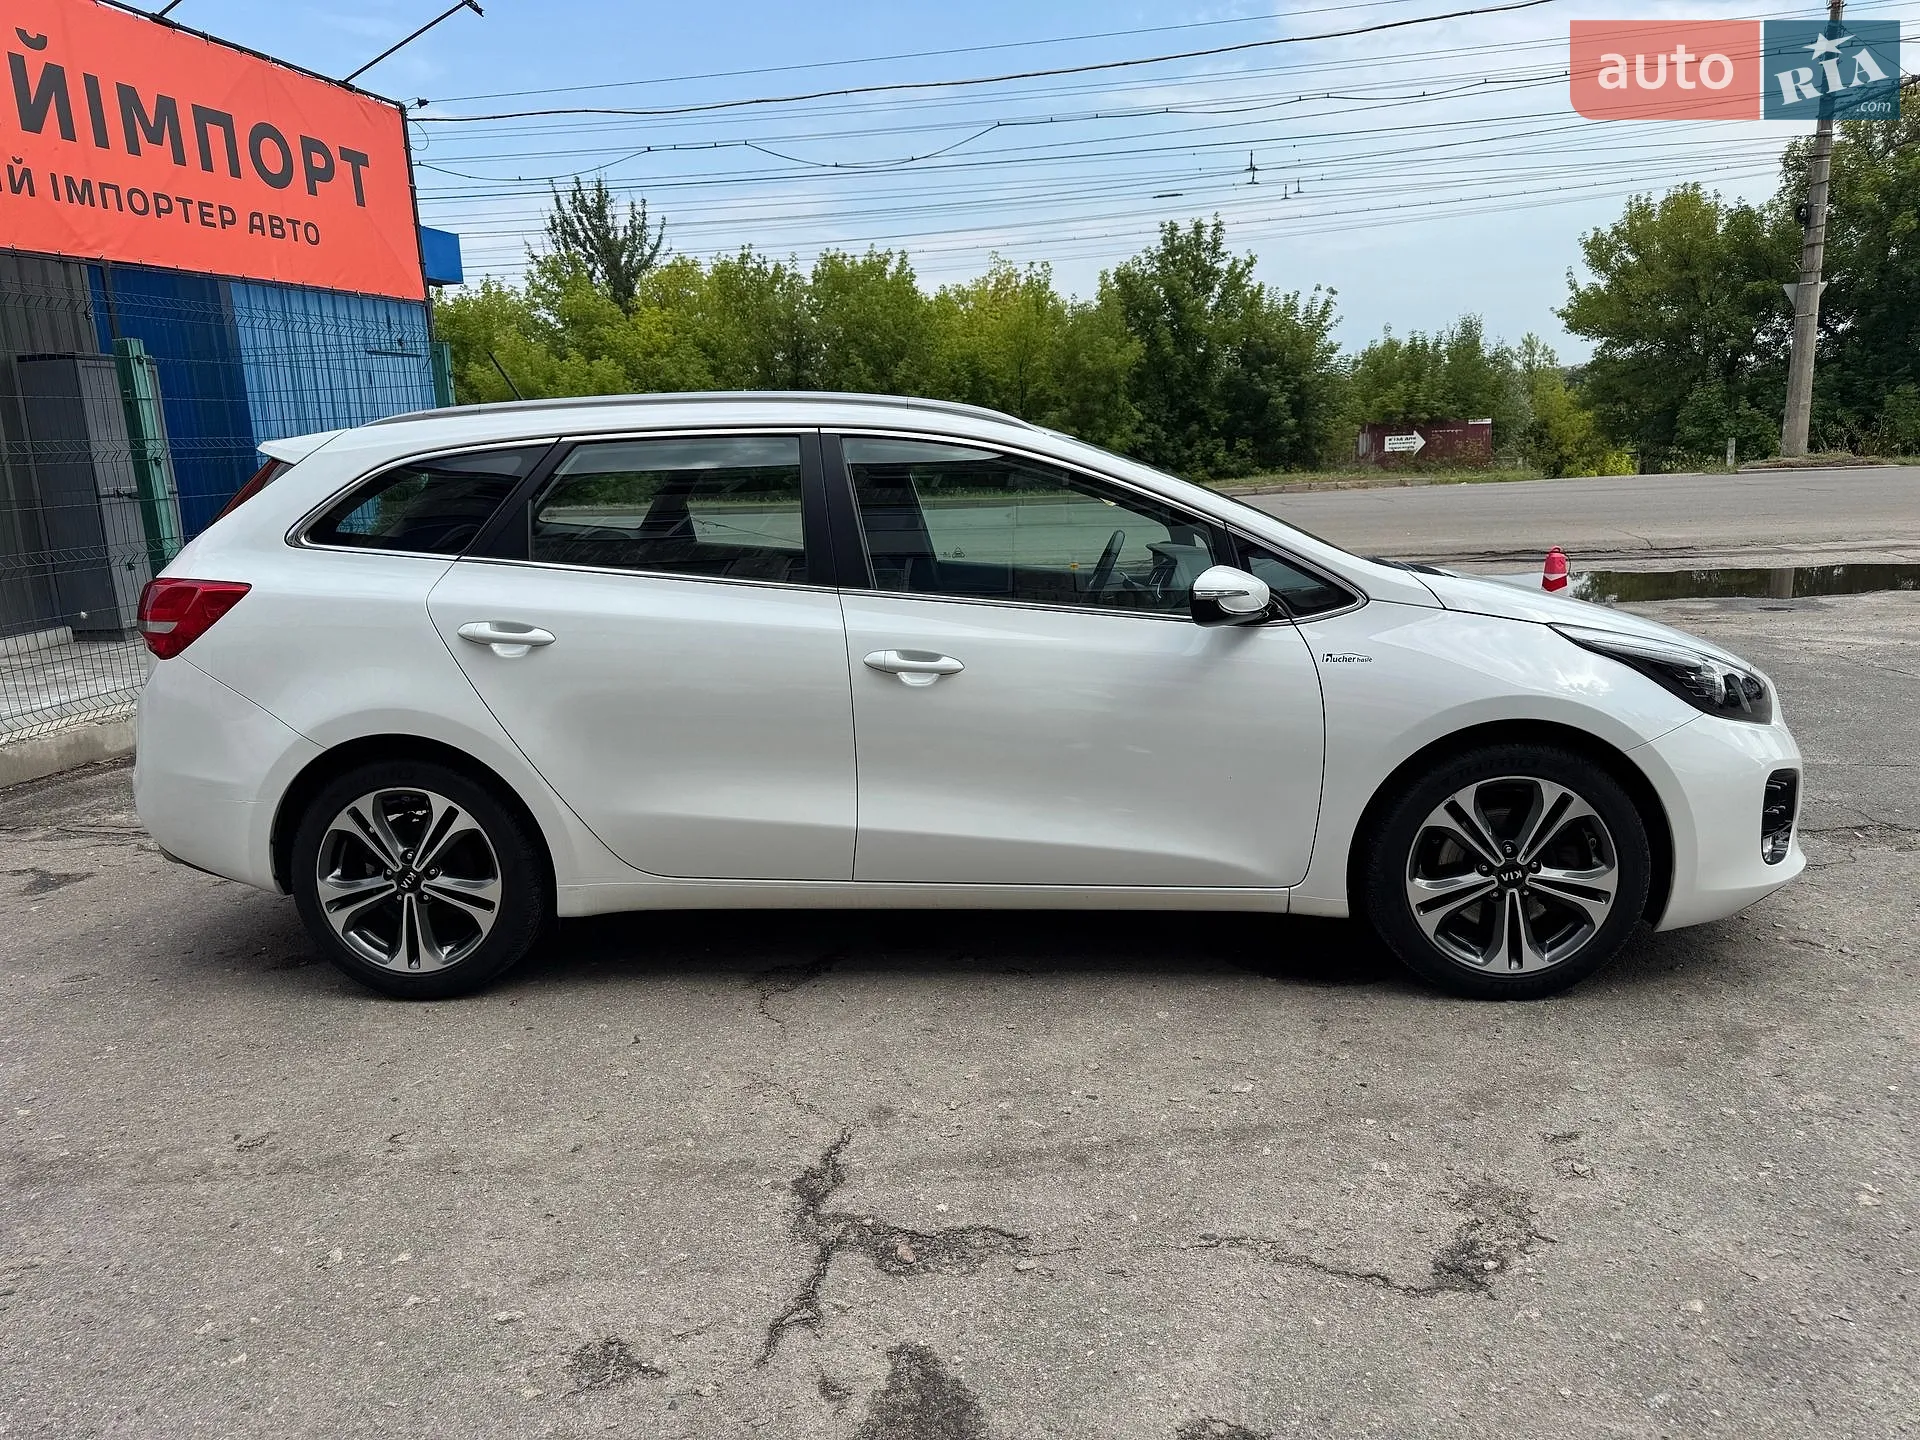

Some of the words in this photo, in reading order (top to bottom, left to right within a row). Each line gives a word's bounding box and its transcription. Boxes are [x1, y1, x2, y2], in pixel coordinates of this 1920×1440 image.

[0, 156, 36, 197] Й
[50, 172, 237, 230] ІМПОРТЕР
[249, 211, 320, 246] АВТО
[400, 872, 416, 888] KIA
[1500, 870, 1522, 881] KIA
